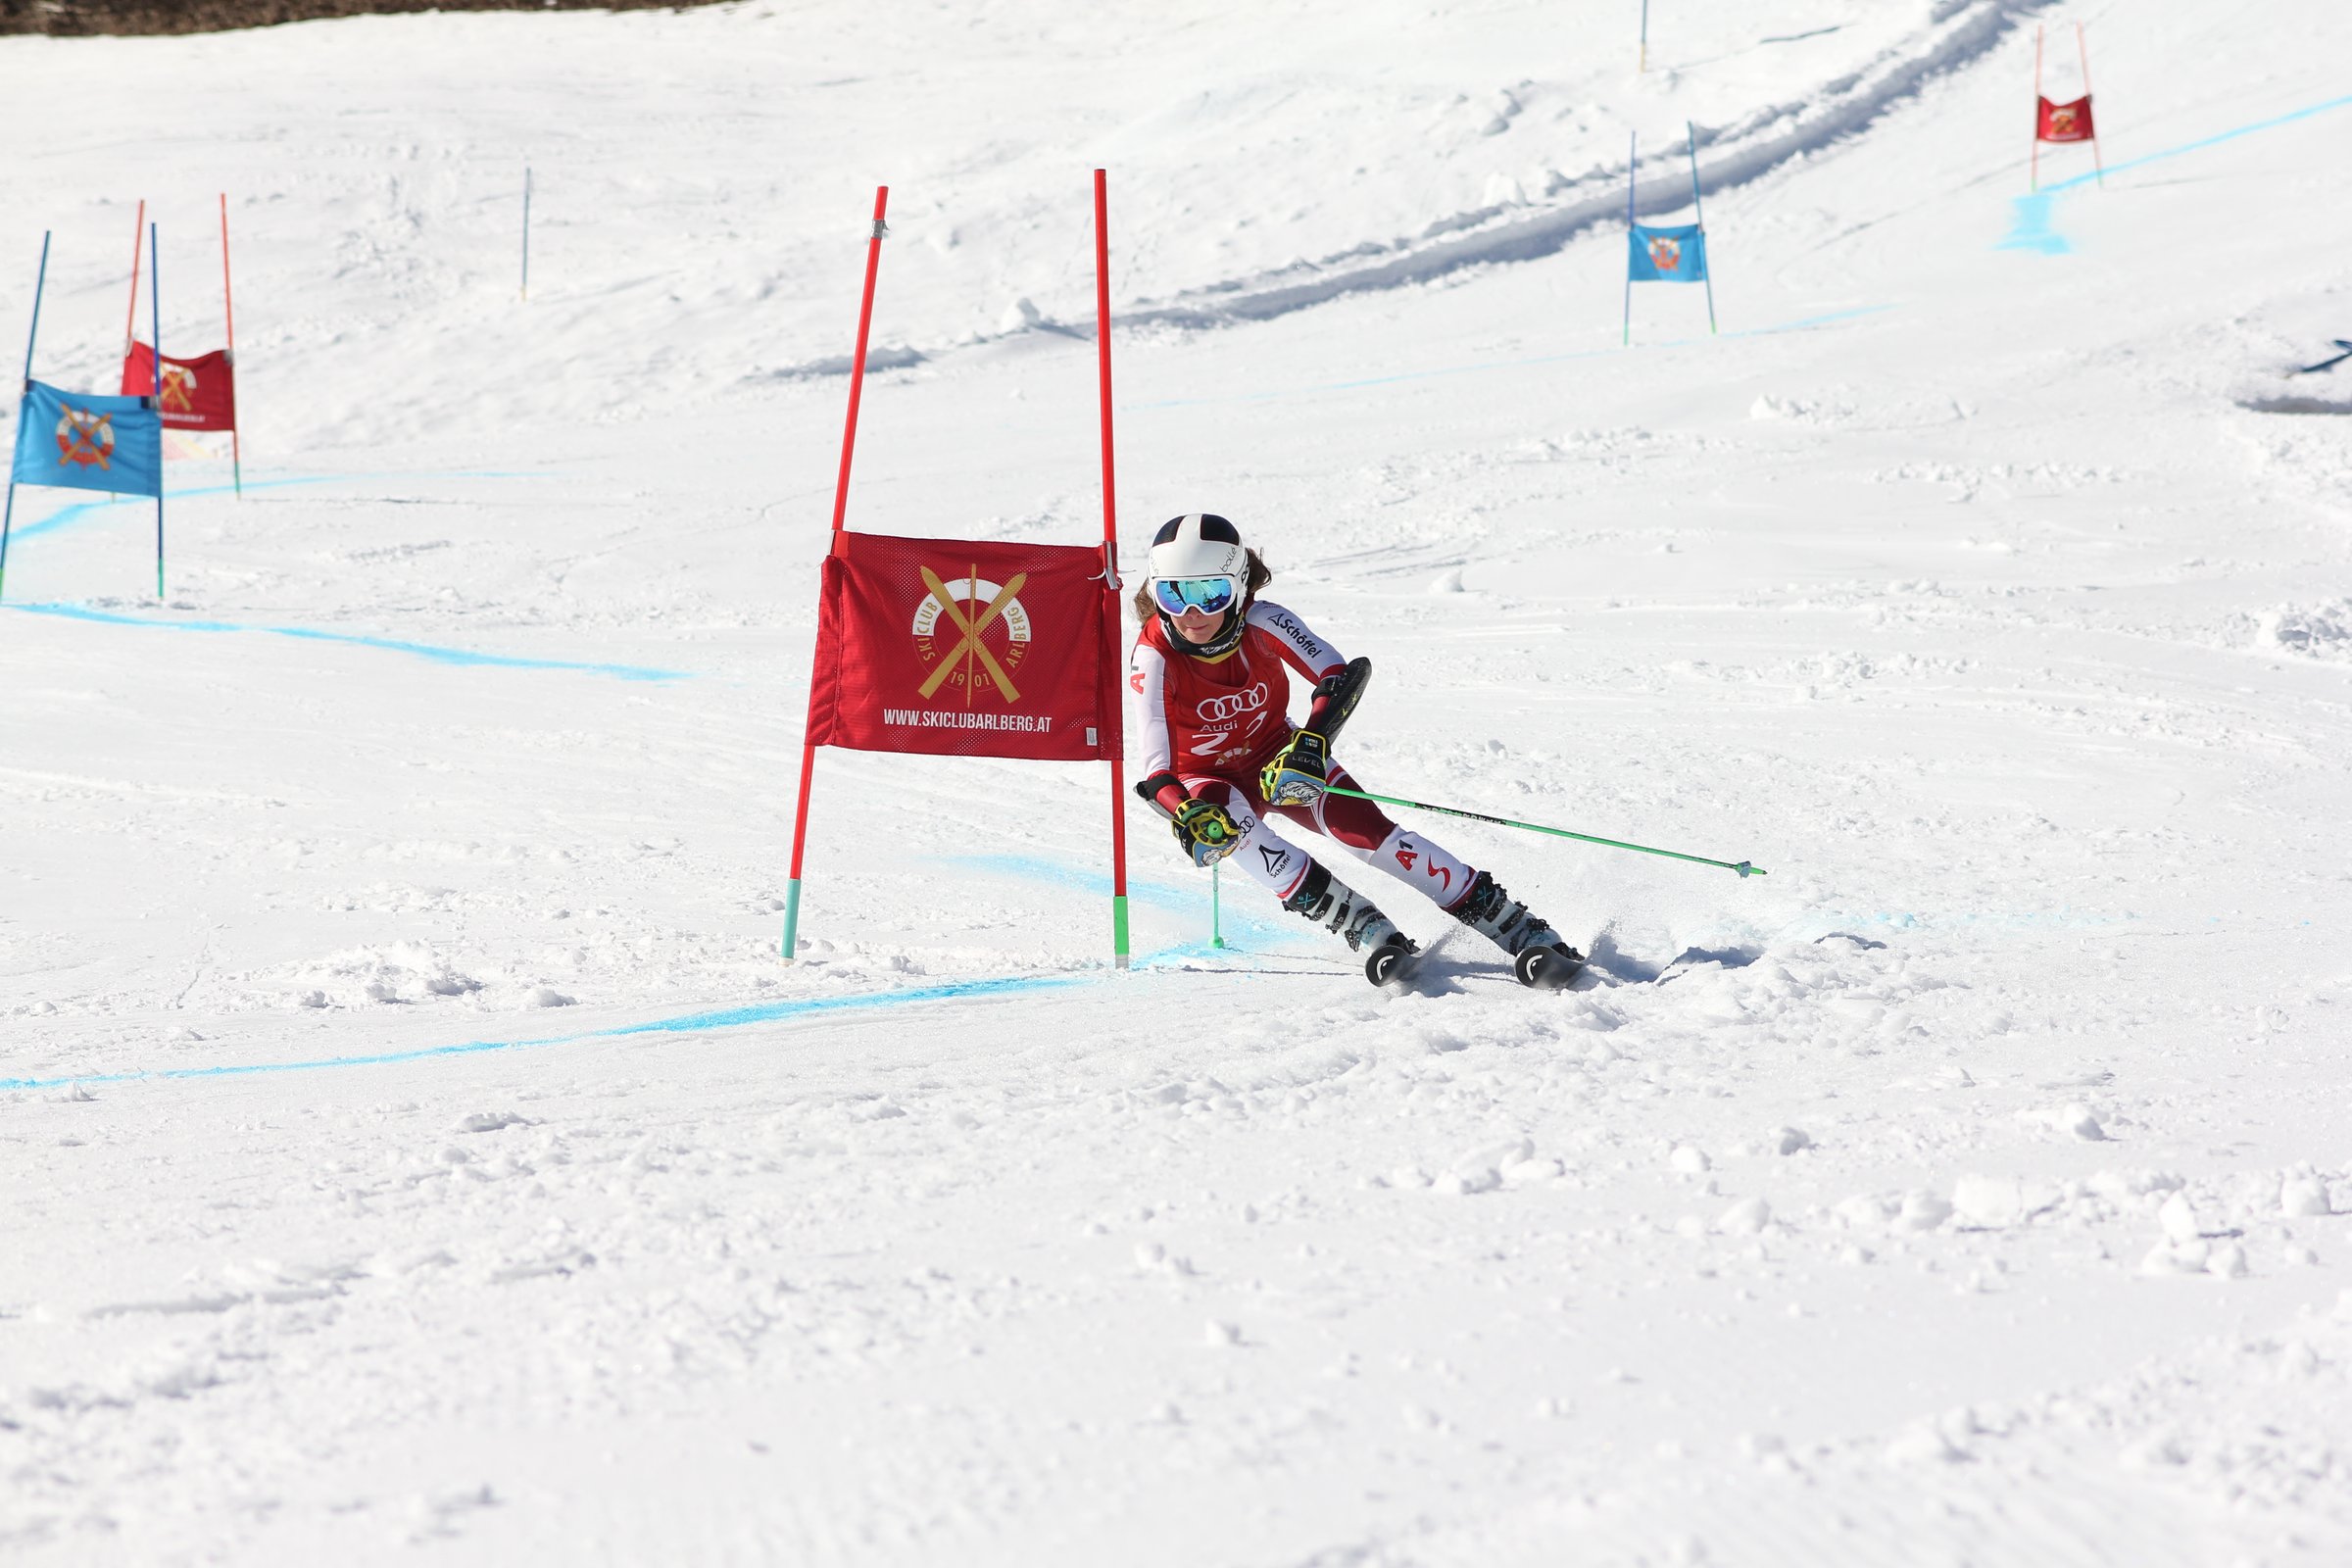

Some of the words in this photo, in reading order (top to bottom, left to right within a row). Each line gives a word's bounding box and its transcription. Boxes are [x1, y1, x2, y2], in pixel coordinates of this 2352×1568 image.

[916, 601, 938, 662] SKICLUB
[1005, 607, 1027, 668] ARLBERG
[1279, 618, 1323, 659] Schöffel
[883, 708, 1053, 733] WWW.SKICLUBARLBERG.AT
[1200, 719, 1238, 732] Audi
[1292, 755, 1321, 768] LEVEL
[1239, 838, 1251, 852] Audi
[1395, 839, 1419, 871] A1
[1270, 854, 1292, 879] Schöffel
